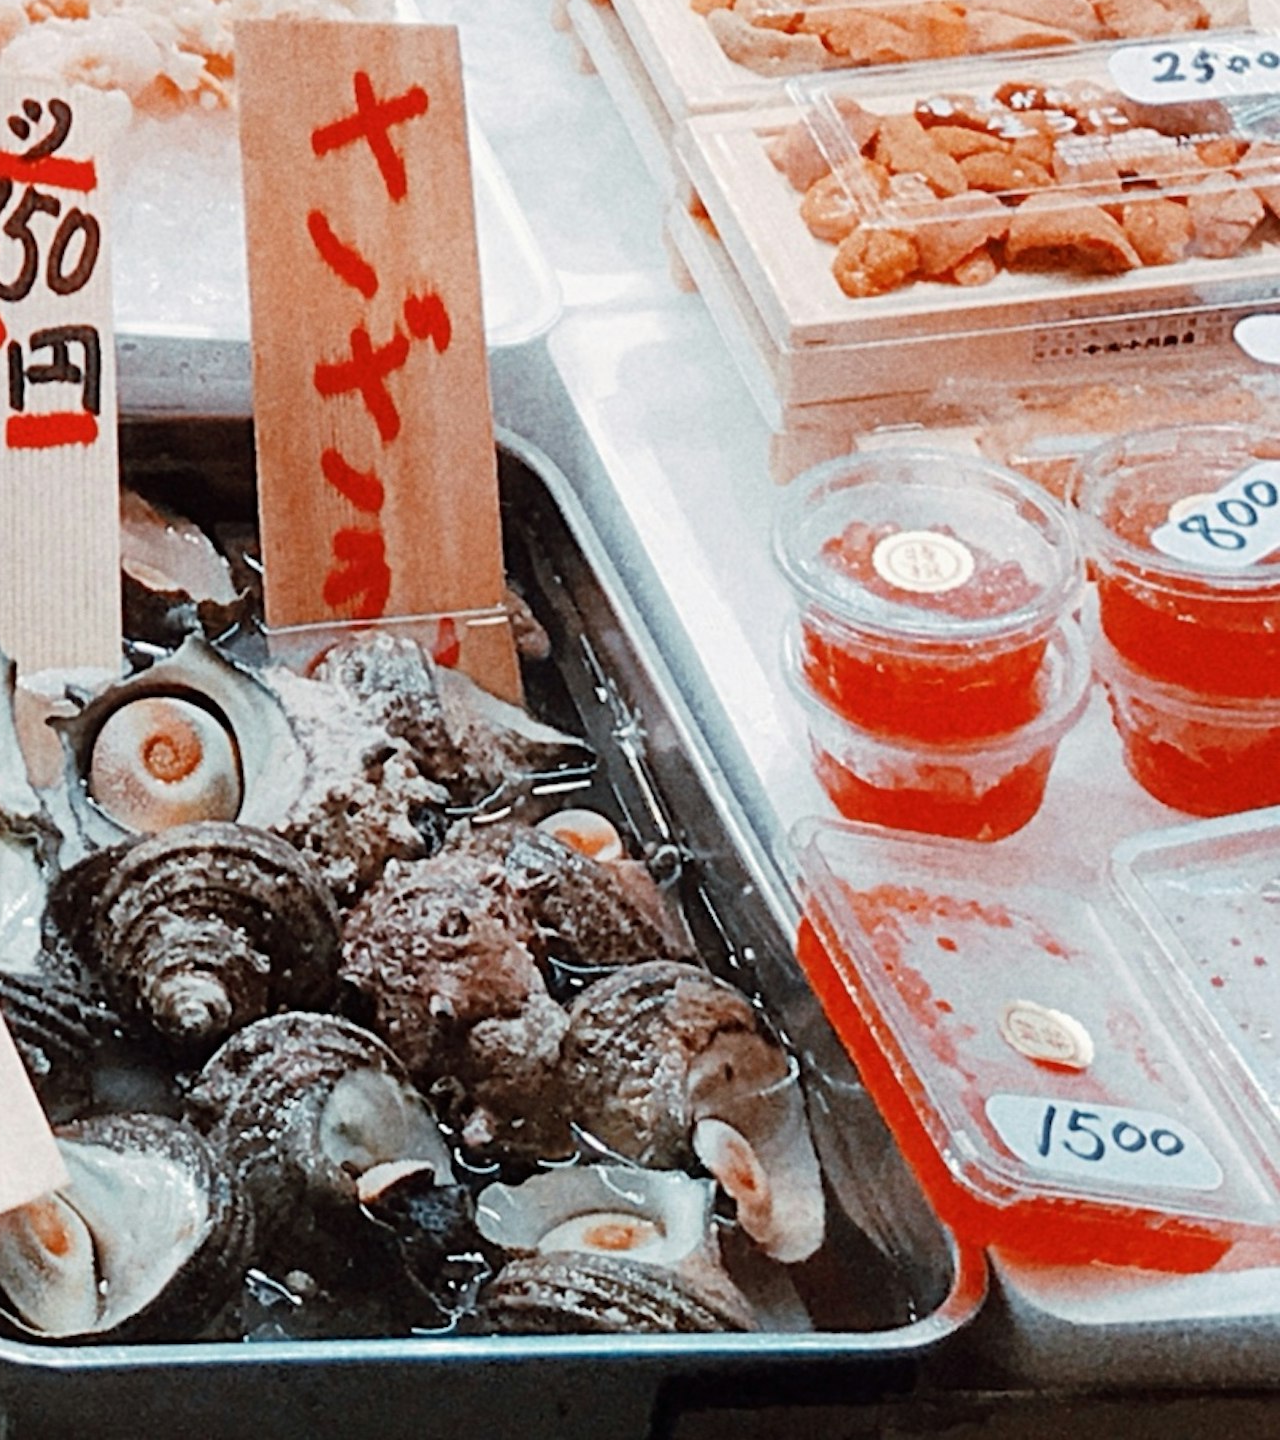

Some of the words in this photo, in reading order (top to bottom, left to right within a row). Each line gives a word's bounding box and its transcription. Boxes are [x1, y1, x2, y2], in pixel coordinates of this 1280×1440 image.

[1151, 50, 1280, 85] 2500
[6, 323, 102, 417] 円
[1178, 478, 1280, 551] 800
[1040, 1104, 1185, 1161] 1500
